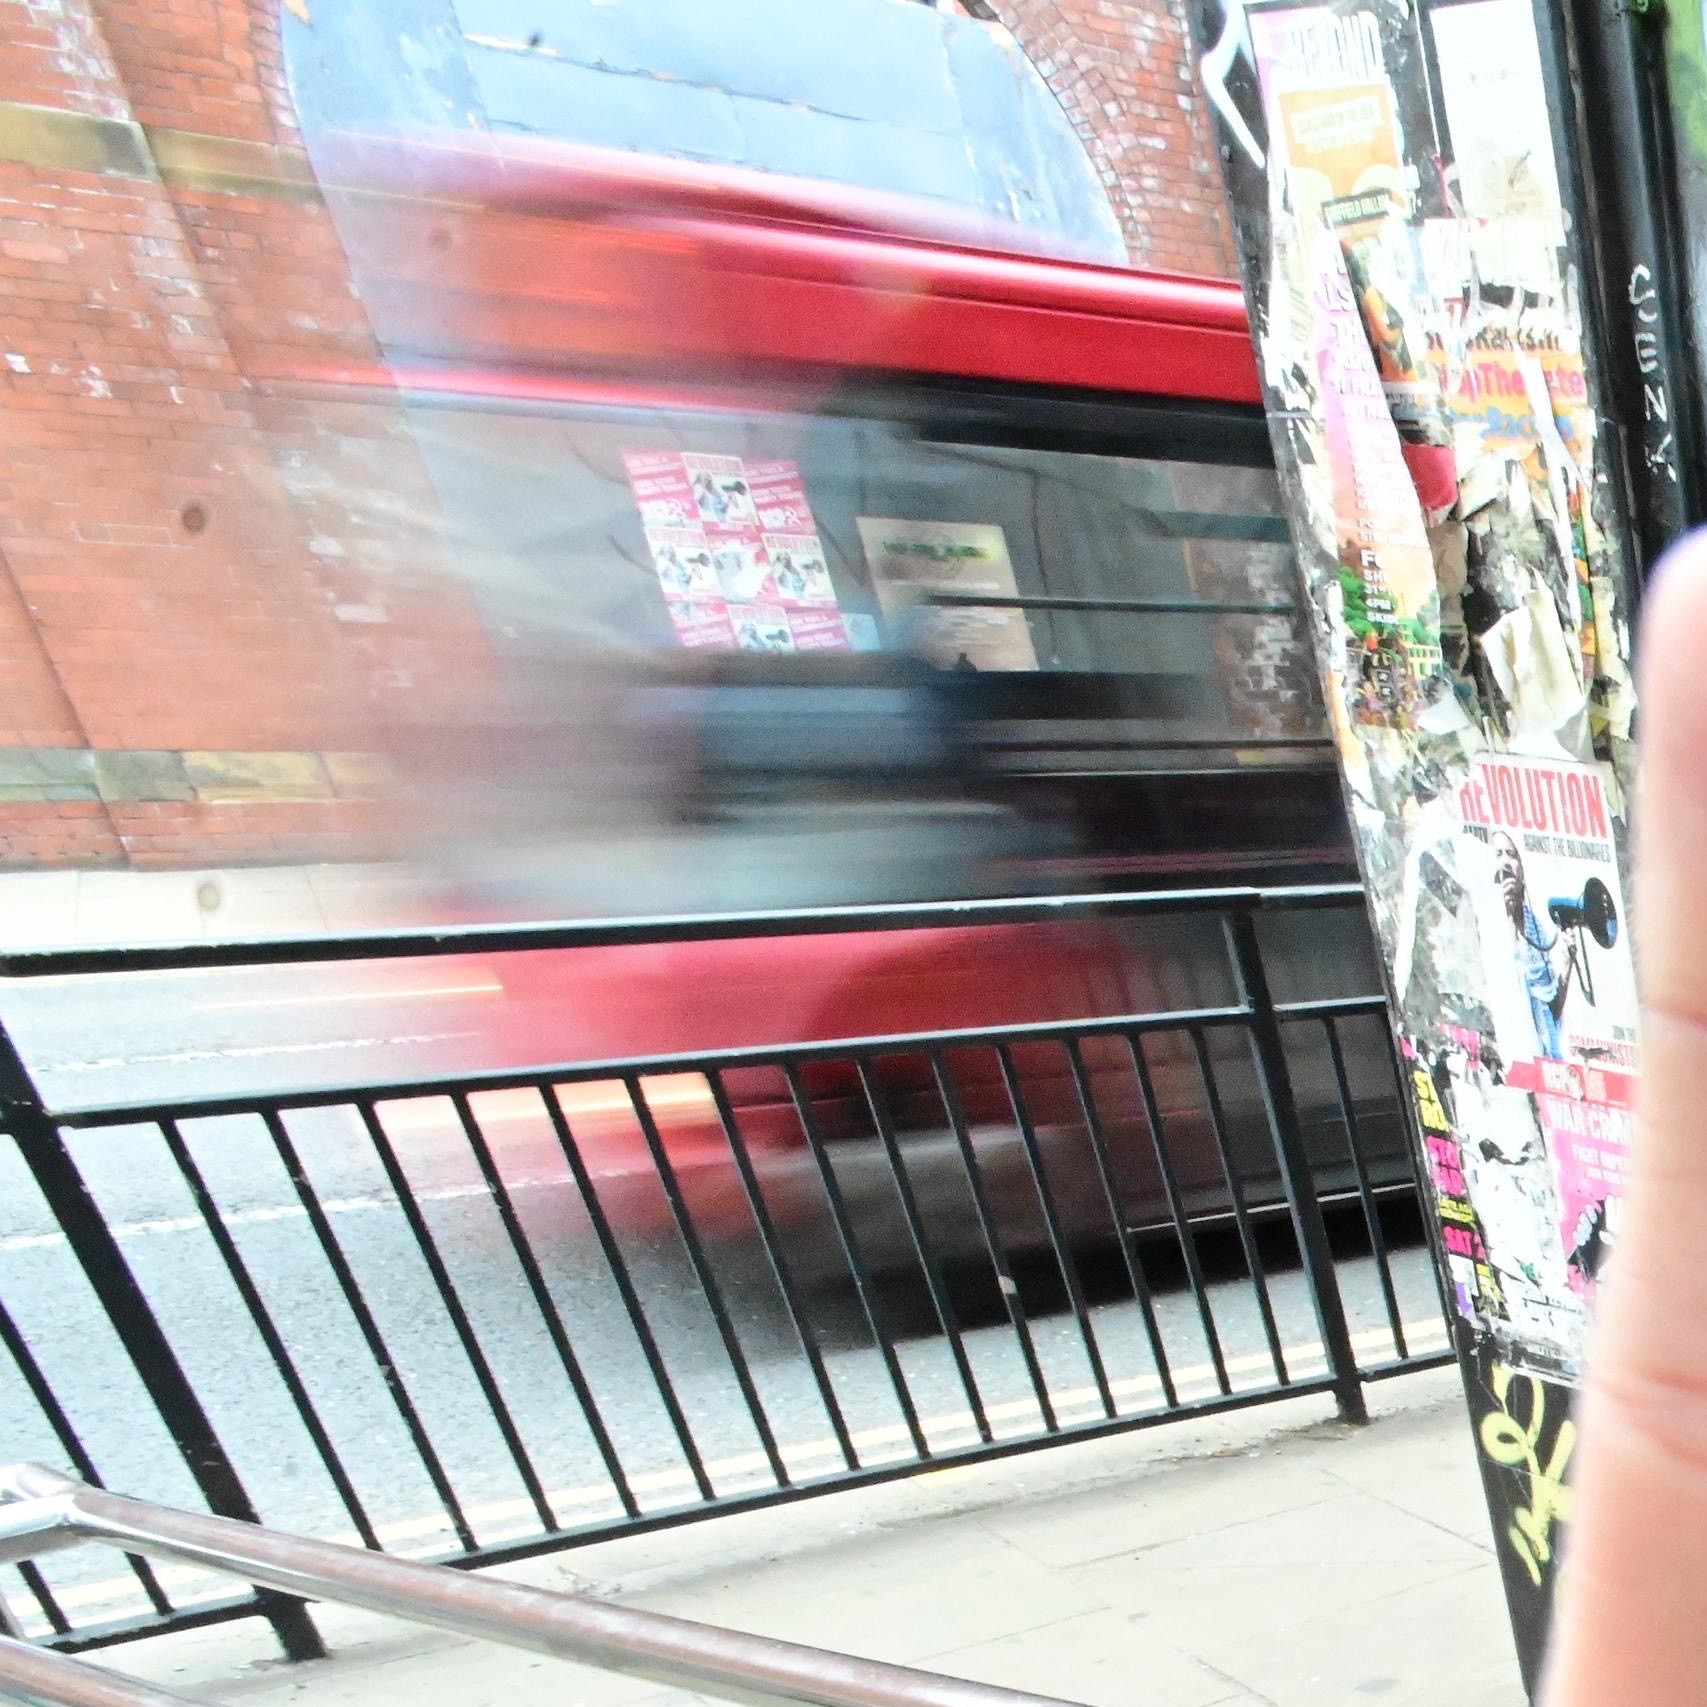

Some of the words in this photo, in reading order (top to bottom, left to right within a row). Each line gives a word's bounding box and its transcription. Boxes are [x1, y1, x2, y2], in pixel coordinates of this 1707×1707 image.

[1460, 763, 1608, 839] REVOLUTION
[1552, 837, 1567, 857] THE
[1546, 1098, 1587, 1136] WAR
